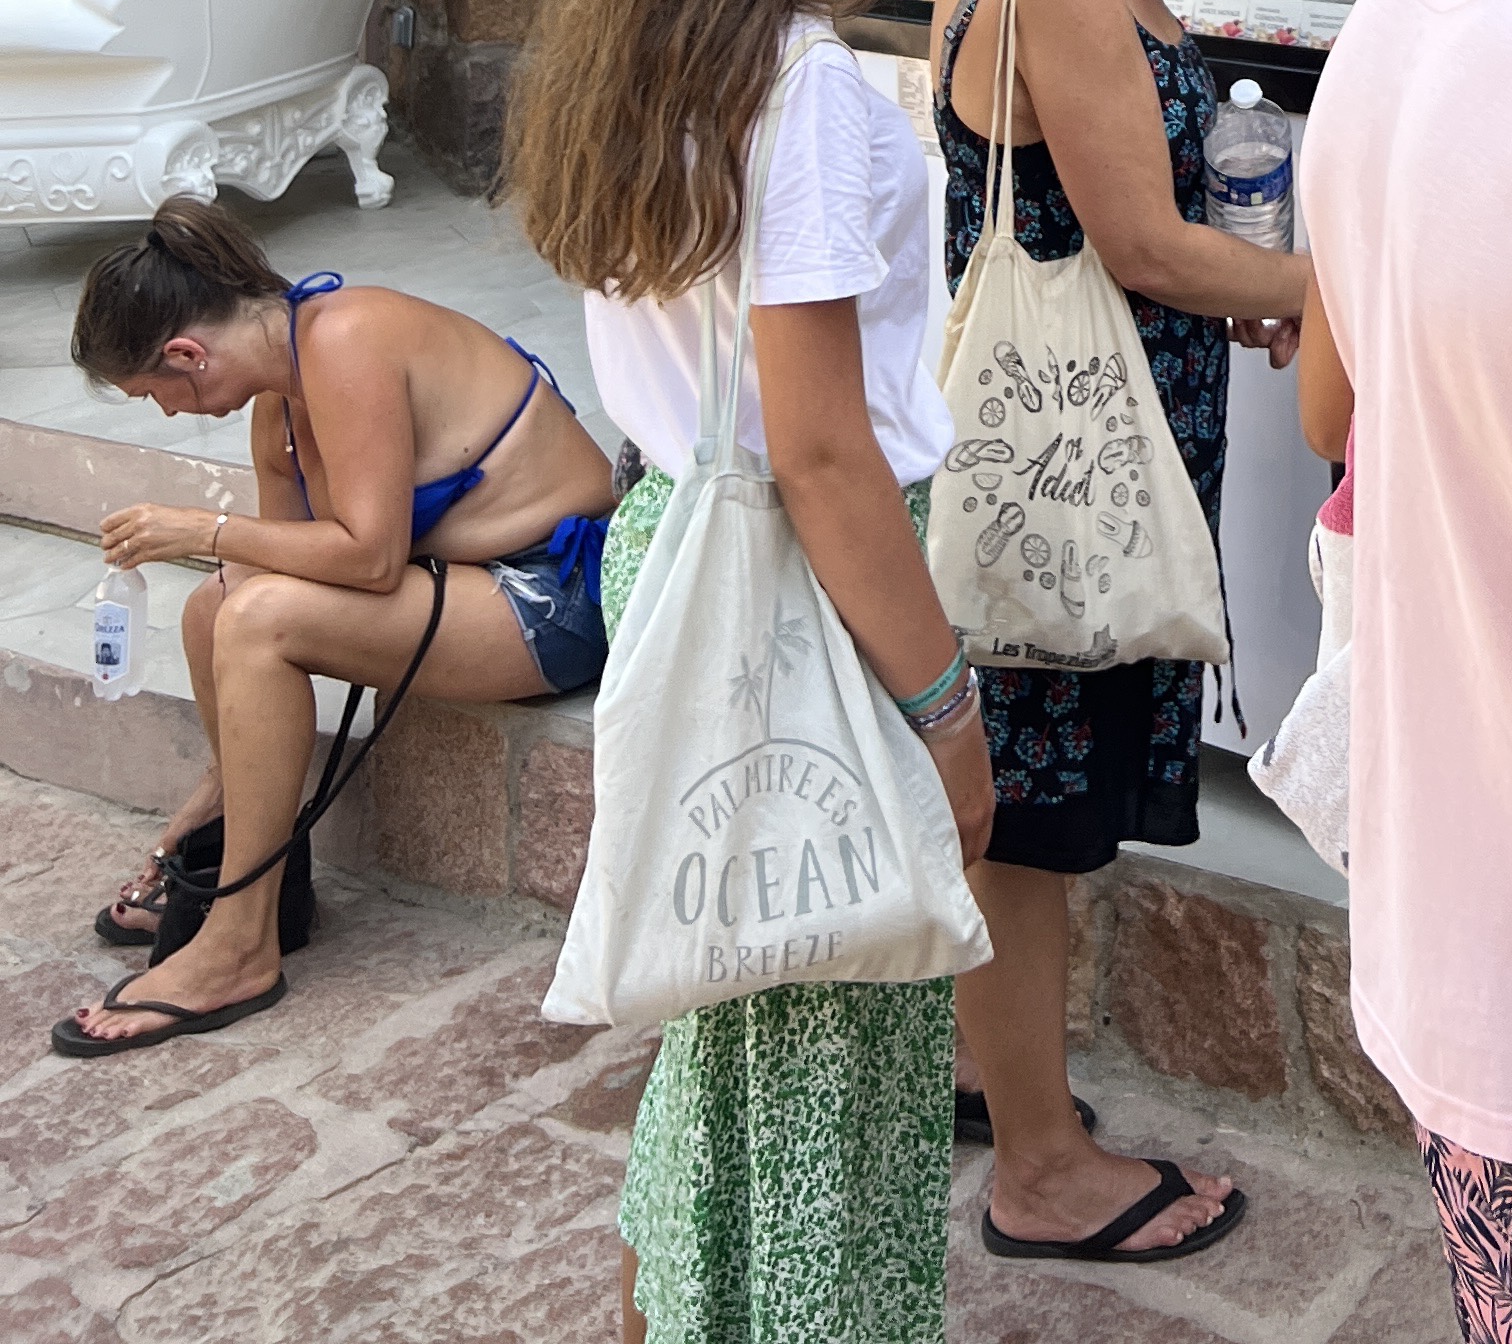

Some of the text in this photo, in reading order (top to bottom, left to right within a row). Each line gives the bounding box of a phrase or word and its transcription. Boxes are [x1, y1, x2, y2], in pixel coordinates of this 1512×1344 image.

[993, 637, 1021, 657] Les
[673, 827, 880, 927] OCEAN
[707, 930, 843, 983] BREEZE
